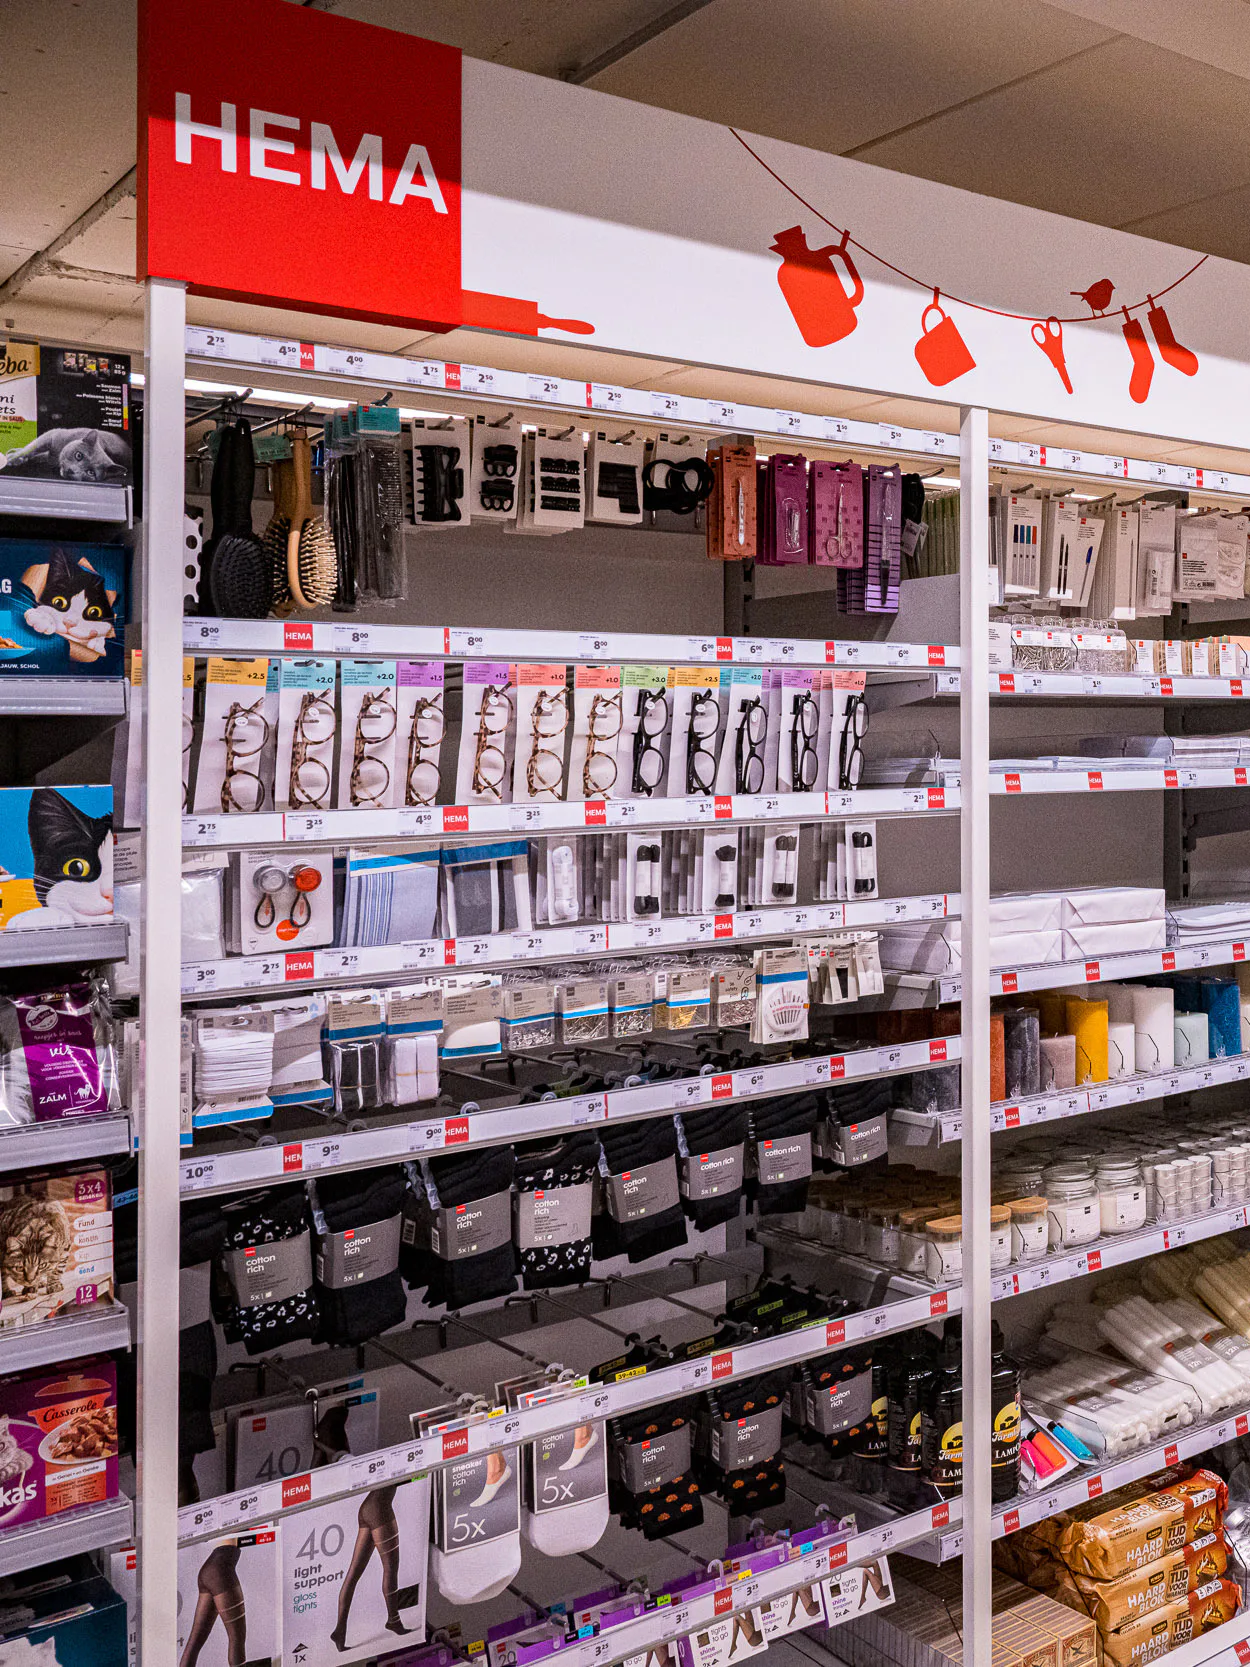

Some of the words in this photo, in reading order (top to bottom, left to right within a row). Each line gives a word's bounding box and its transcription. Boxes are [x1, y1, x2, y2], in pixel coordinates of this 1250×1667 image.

[174, 92, 449, 214] HEMA
[206, 335, 225, 346] 275
[278, 345, 297, 356] 450
[346, 354, 363, 365] 400
[422, 366, 438, 376] 175
[478, 373, 494, 383] 250
[200, 627, 219, 638] 800
[285, 632, 312, 641] HEMA
[352, 632, 369, 643] 800
[467, 636, 483, 646] 800
[701, 644, 715, 653] 600
[928, 652, 944, 660] HEMA
[247, 672, 265, 680] +2.5
[316, 675, 334, 684] +2.0
[376, 672, 395, 681] +2.0
[651, 676, 666, 684] +3.0
[1000, 680, 1015, 688] HEMA
[928, 794, 945, 803] HEMA
[621, 806, 635, 816] 225
[306, 819, 323, 830] 325
[415, 814, 432, 825] 450
[445, 815, 468, 824] HEMA
[198, 823, 216, 834] 275
[699, 921, 713, 932] 500
[286, 961, 313, 971] HEMA
[341, 955, 358, 966] 275
[262, 963, 280, 974] 275
[197, 969, 216, 981] 300
[931, 1046, 947, 1056] HEMA
[713, 1084, 732, 1093] HEMA
[39, 1093, 67, 1105] ZALM
[426, 1128, 442, 1140] 900
[322, 1144, 340, 1157] 950
[701, 1158, 720, 1171] cotton
[721, 1156, 735, 1167] rich
[185, 1165, 214, 1179] 1000
[534, 1198, 560, 1210] cotton
[534, 1205, 550, 1216] rich
[78, 1219, 95, 1228] rund
[343, 1236, 371, 1249] cotton
[343, 1245, 361, 1257] rich
[246, 1254, 276, 1267] cotton
[246, 1263, 265, 1274] rich
[79, 1285, 93, 1299] 12
[827, 1329, 845, 1339] HEMA
[713, 1361, 732, 1373] HEMA
[43, 1400, 98, 1423] Casserole
[504, 1421, 520, 1434] 600
[443, 1437, 468, 1451] HEMA
[542, 1433, 564, 1444] cotton
[542, 1441, 556, 1451] rich
[642, 1444, 666, 1457] cotton
[255, 1447, 301, 1480] 40
[642, 1454, 659, 1464] rich
[452, 1458, 483, 1474] sneaker
[452, 1469, 476, 1480] cotton
[452, 1477, 467, 1487] rich
[283, 1483, 310, 1498] HEMA
[541, 1476, 574, 1504] 5x
[239, 1496, 258, 1511] 800
[194, 1510, 213, 1525] 800
[932, 1512, 949, 1522] HEMA
[451, 1513, 486, 1542] 5x
[1167, 1524, 1186, 1538] TIJD
[295, 1524, 345, 1561] 40
[1166, 1536, 1185, 1547] VOOR
[1126, 1536, 1164, 1562] HAARD
[830, 1551, 847, 1562] HEMA
[1136, 1547, 1164, 1568] BLOK
[294, 1564, 323, 1580] light
[1170, 1569, 1188, 1581] TIJD
[293, 1570, 345, 1590] support
[842, 1577, 857, 1588] tights
[850, 1585, 859, 1594] go
[1169, 1581, 1187, 1592] VOOR
[293, 1590, 317, 1606] gloss
[1127, 1582, 1166, 1608] HAARD
[293, 1600, 318, 1614] tights
[832, 1597, 846, 1607] shine
[1138, 1592, 1165, 1614] BLOK
[675, 1611, 689, 1624] 325
[1131, 1631, 1169, 1659] HAARD
[294, 1653, 307, 1664] 1x
[1141, 1642, 1168, 1665] BLOK
